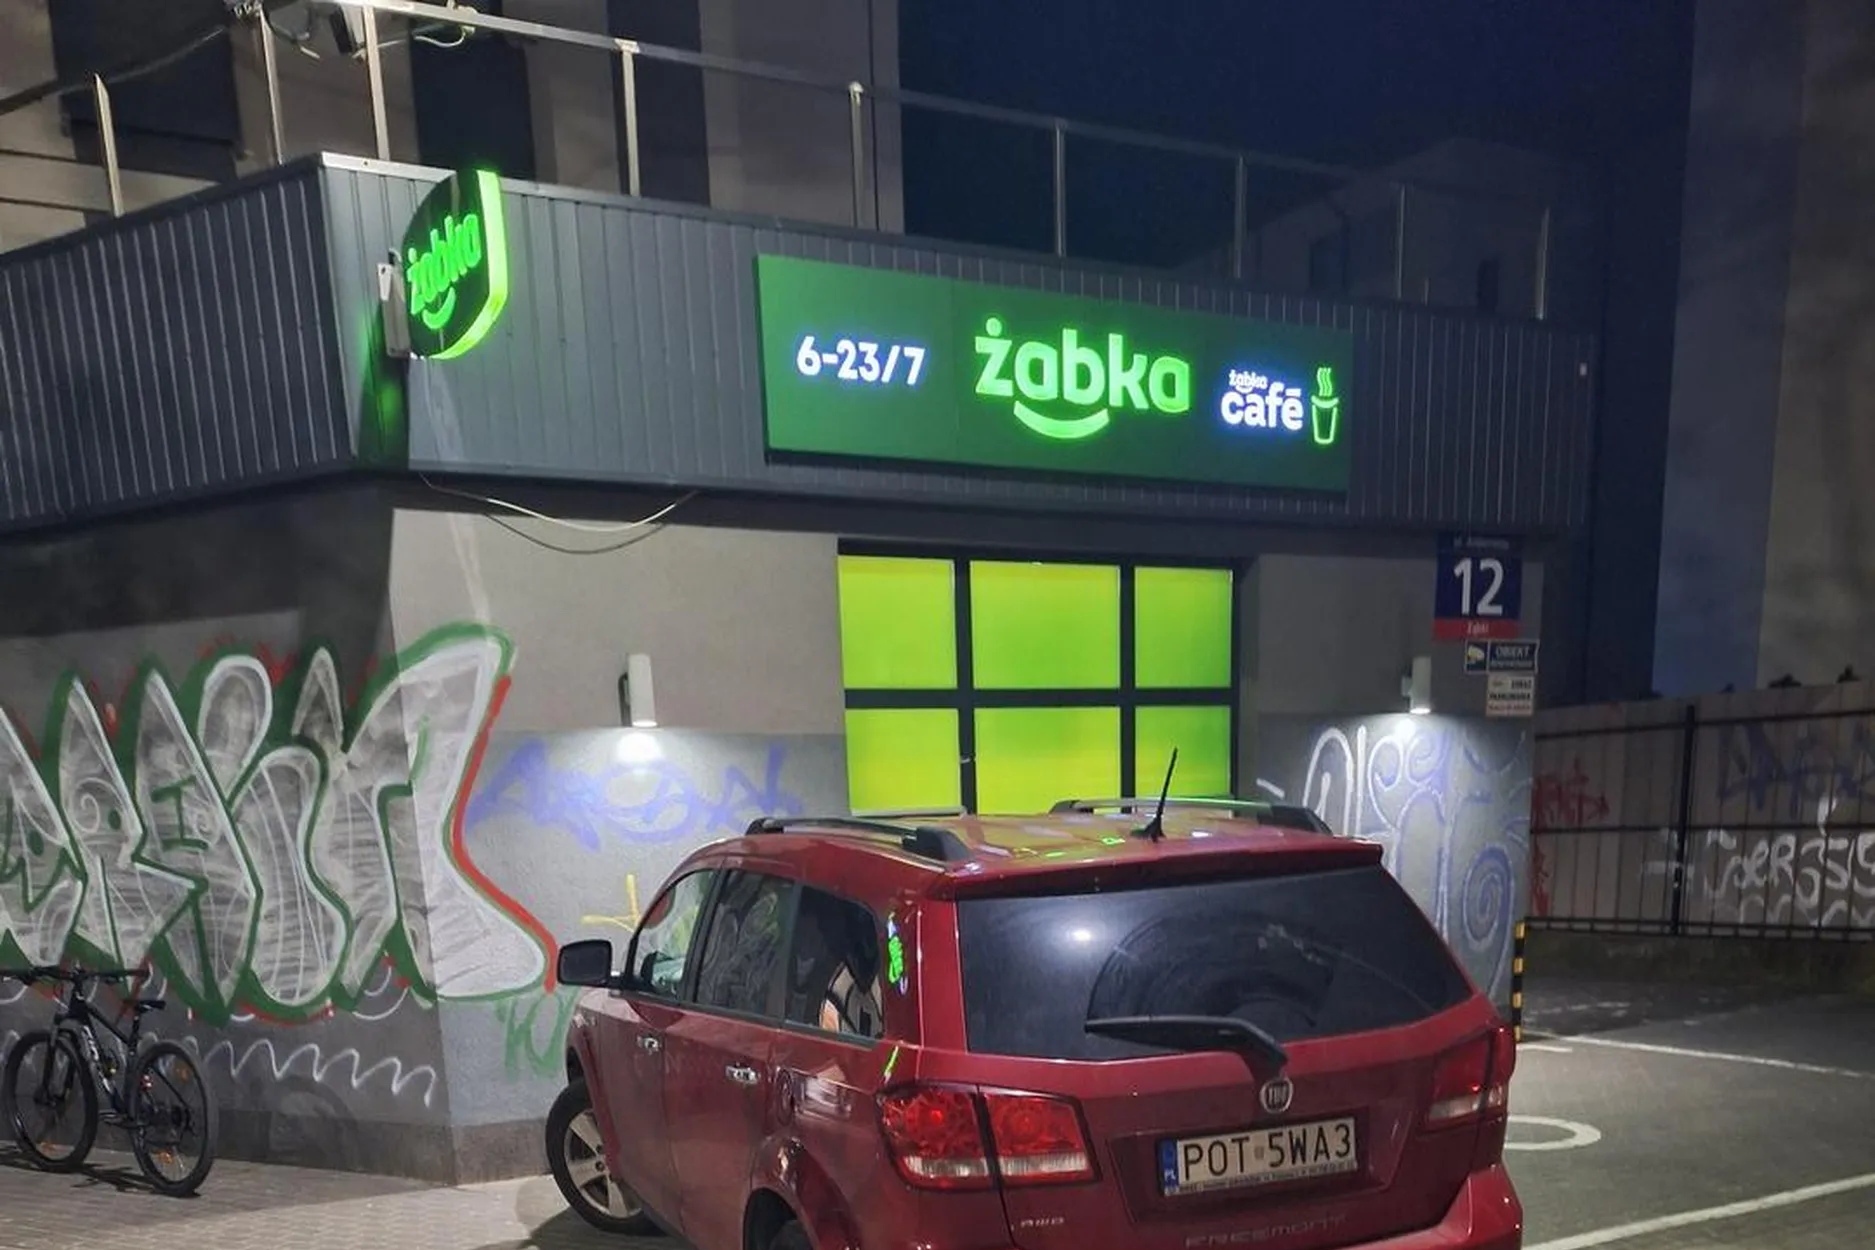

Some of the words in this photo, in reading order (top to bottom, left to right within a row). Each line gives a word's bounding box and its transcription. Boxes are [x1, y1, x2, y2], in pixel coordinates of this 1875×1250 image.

[406, 214, 481, 315] żabka
[796, 336, 926, 386] 6-23/7
[974, 317, 1191, 413] żabka
[1453, 556, 1505, 616] 12
[1183, 1137, 1250, 1181] POT
[1267, 1123, 1350, 1168] 5WA3
